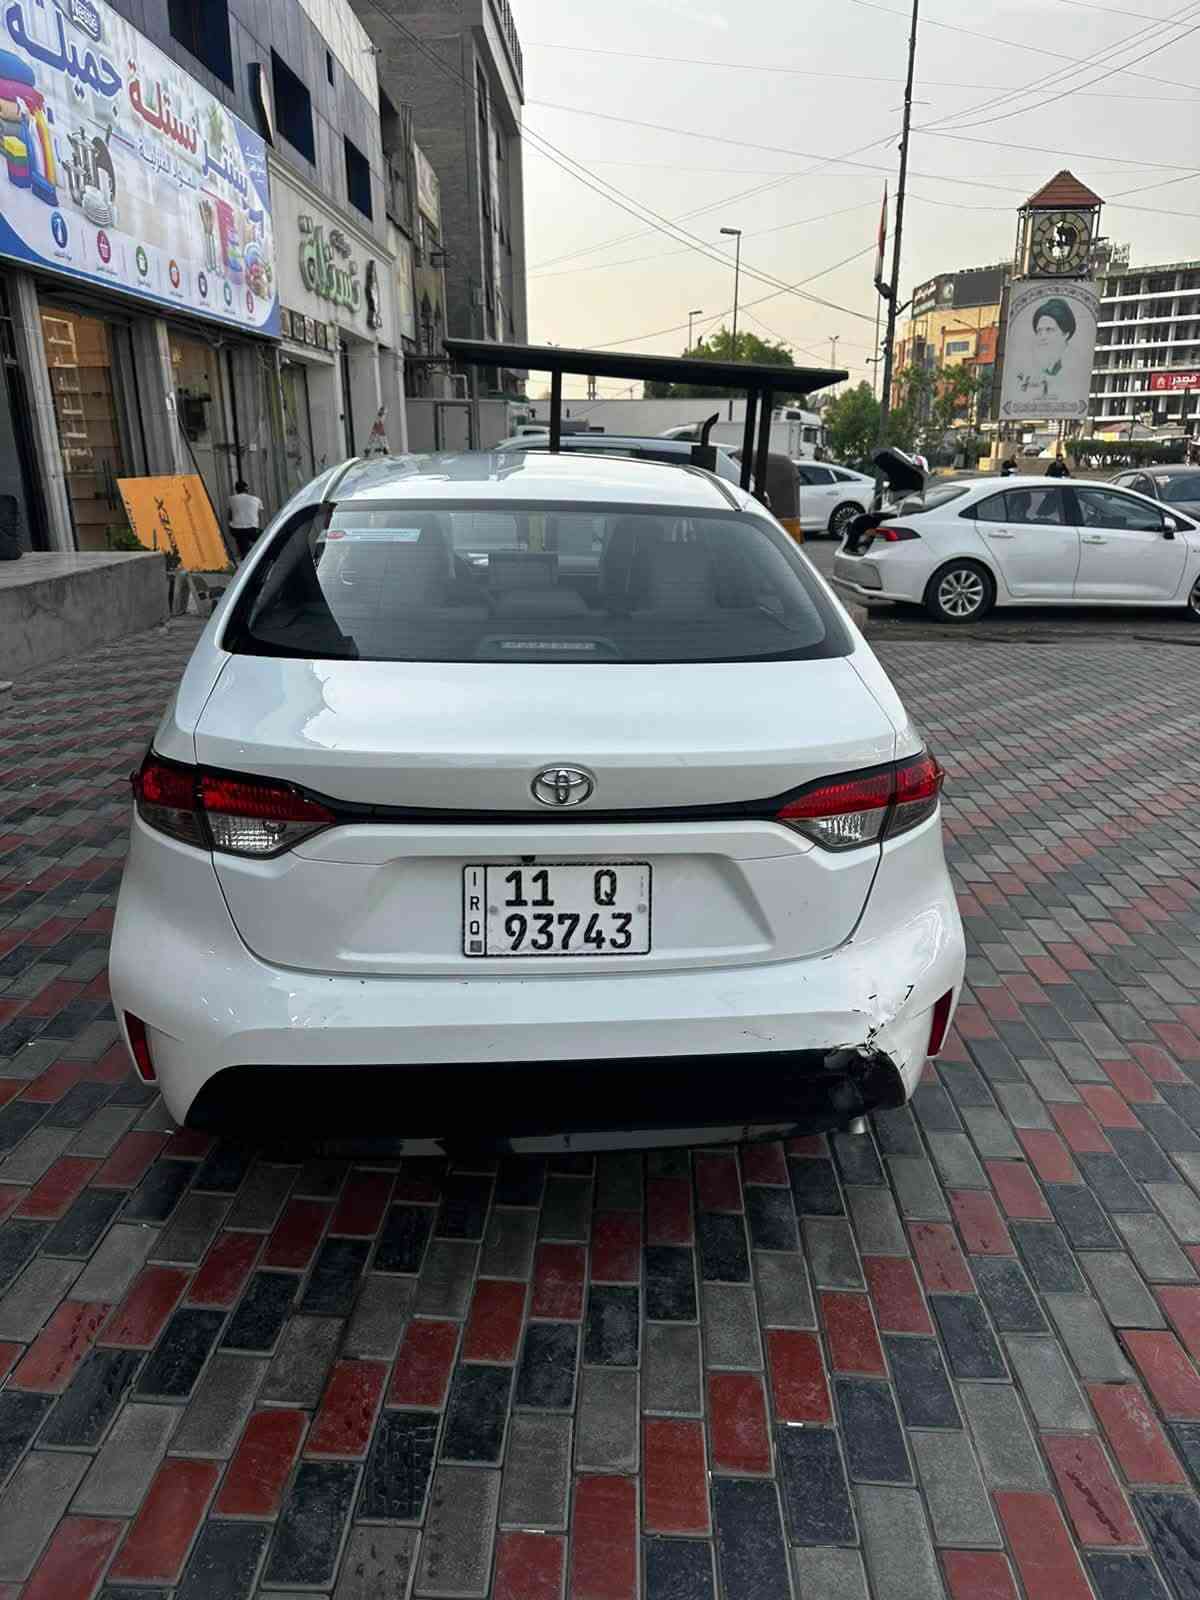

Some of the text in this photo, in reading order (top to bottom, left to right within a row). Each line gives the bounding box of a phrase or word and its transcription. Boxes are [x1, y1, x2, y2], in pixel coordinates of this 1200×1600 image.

[505, 869, 554, 907] 11
[594, 869, 618, 906] Q
[504, 912, 632, 951] 93743
